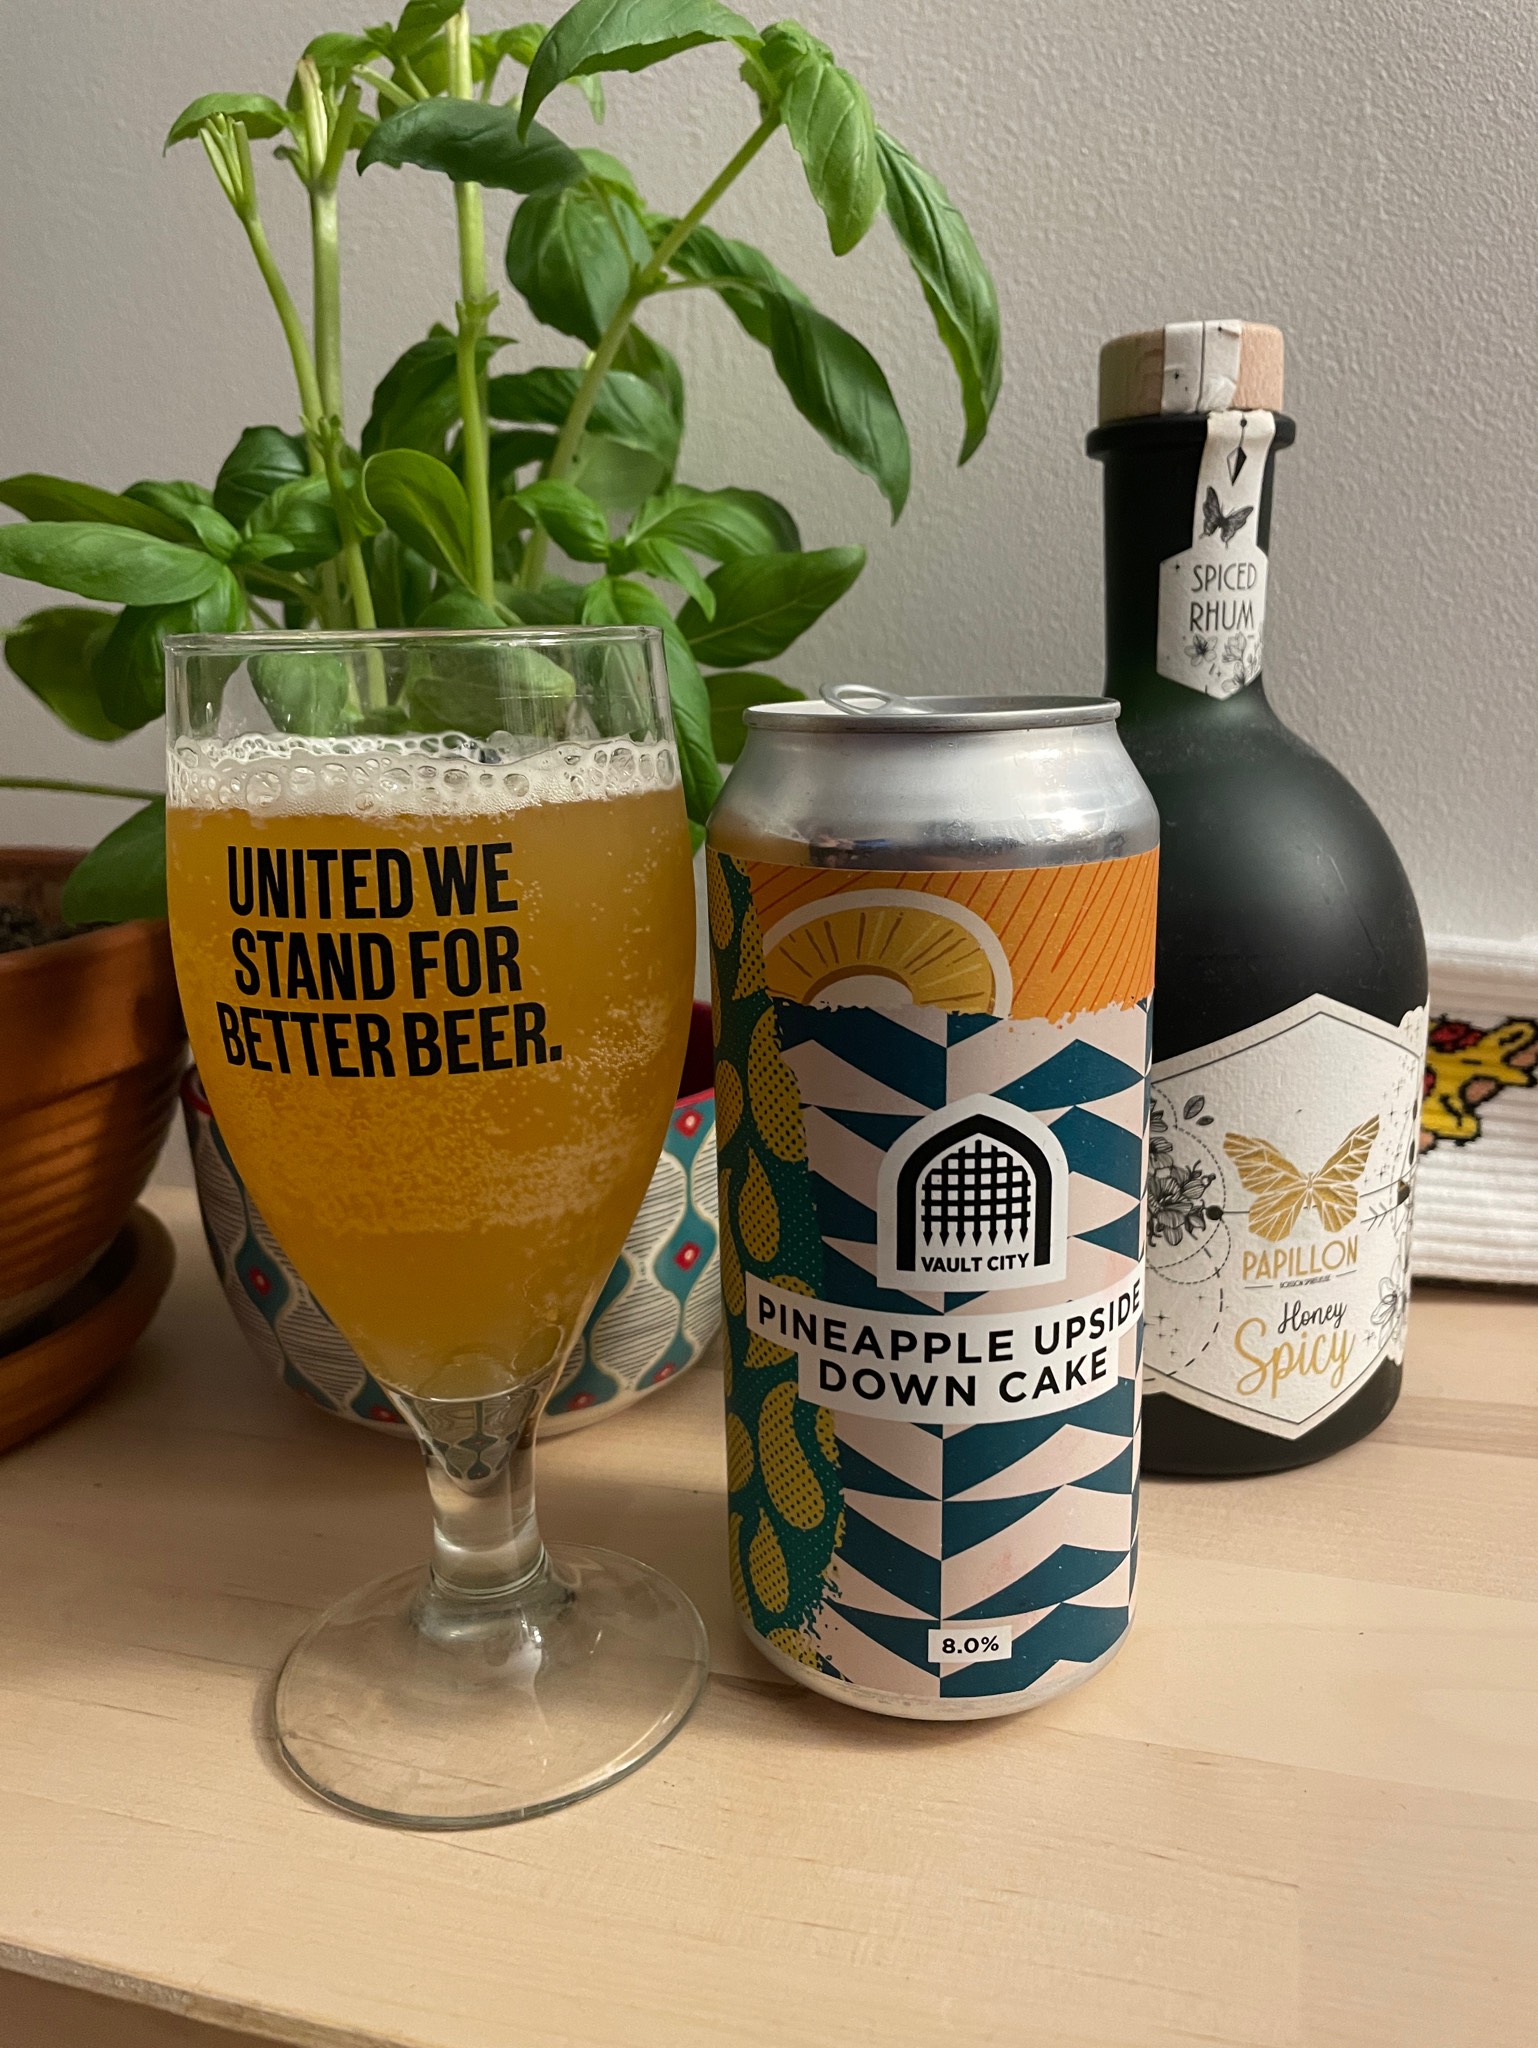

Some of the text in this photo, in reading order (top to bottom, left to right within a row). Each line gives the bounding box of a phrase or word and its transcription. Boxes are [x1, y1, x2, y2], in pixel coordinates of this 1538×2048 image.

[1191, 562, 1258, 592] SPICED
[1189, 599, 1255, 633] RHUM
[227, 842, 519, 920] UNITED WE
[231, 925, 523, 1001] STAND FOR
[215, 1001, 563, 1078] BETTER BEER.
[920, 1252, 1030, 1273] VAULT CITY
[1242, 1234, 1359, 1281] PAPILLON
[757, 1277, 1141, 1364] PINEAPPLE UPSIDE
[1277, 1299, 1348, 1335] Honey
[818, 1345, 1108, 1408] DOWN CAKE
[1233, 1316, 1356, 1399] Spicy
[941, 1635, 1000, 1654] 8.0%
